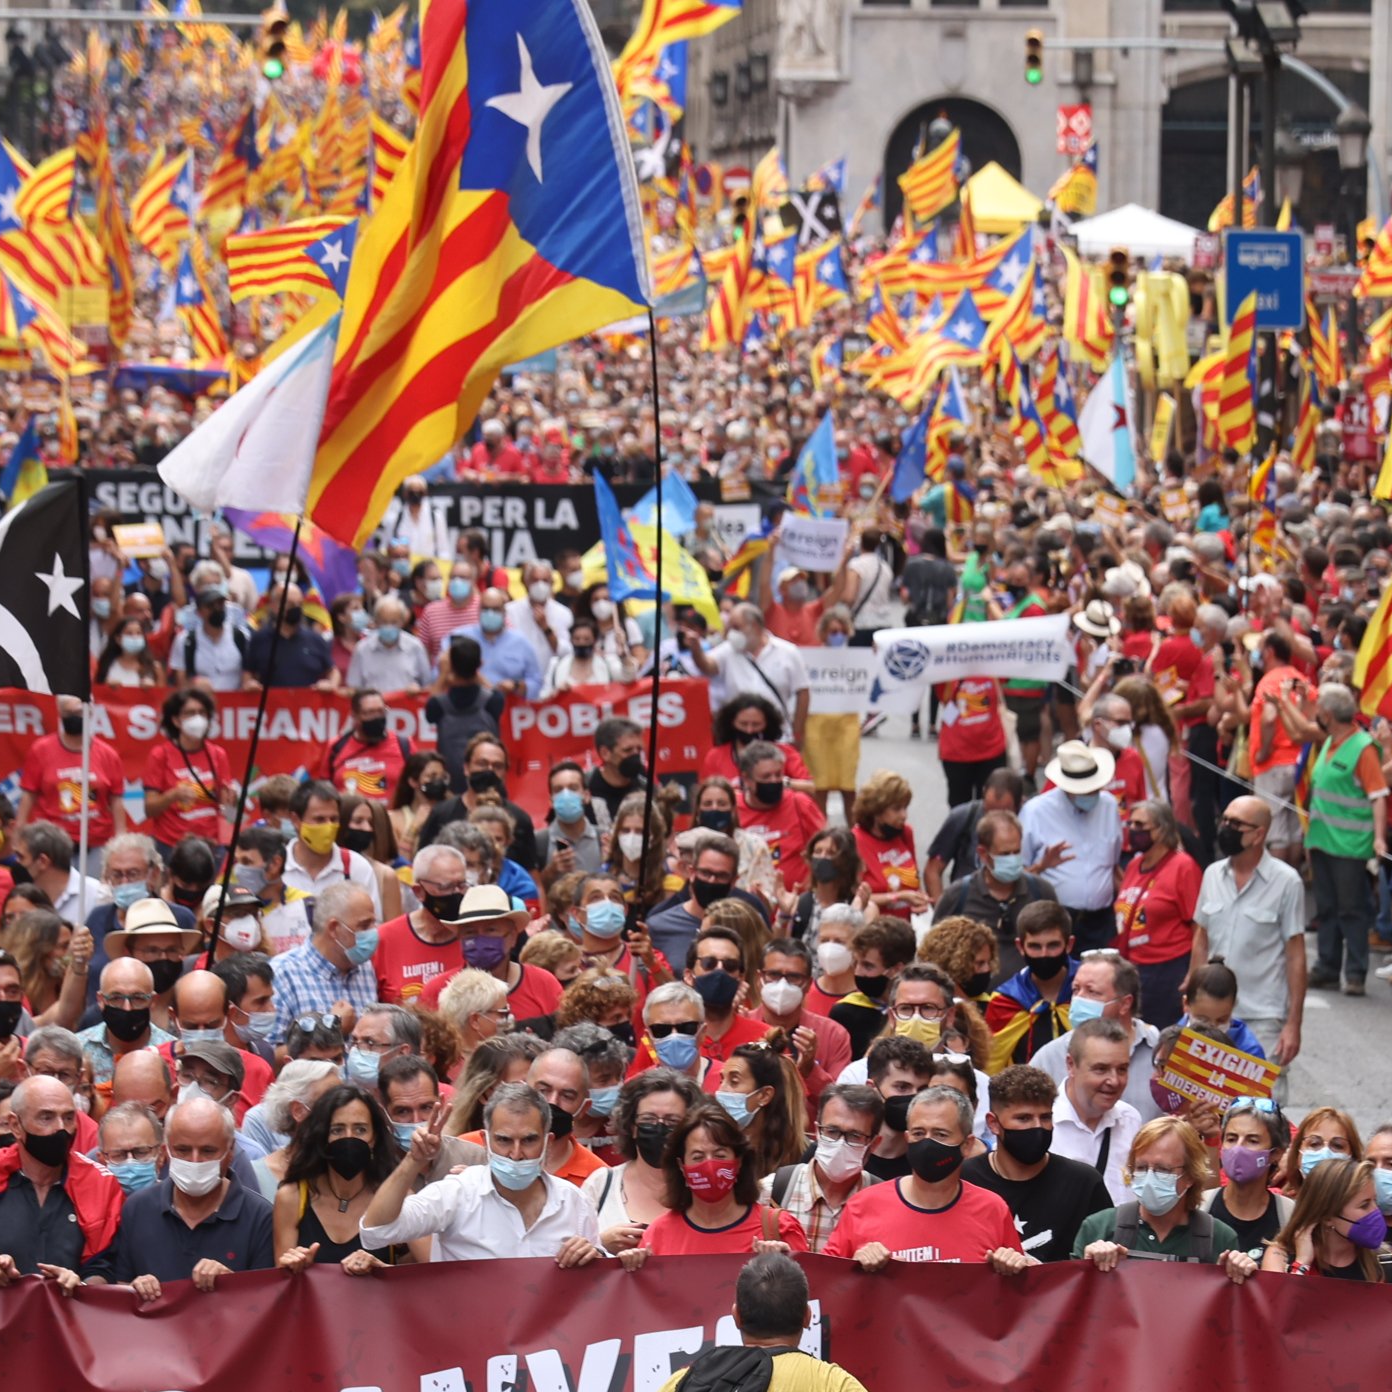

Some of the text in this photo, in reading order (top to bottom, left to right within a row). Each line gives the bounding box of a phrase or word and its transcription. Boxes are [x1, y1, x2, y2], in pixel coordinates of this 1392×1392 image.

[1257, 292, 1280, 312] axi
[460, 497, 527, 528] PER
[534, 500, 580, 530] LA
[1188, 1039, 1266, 1083] EXIGIM
[1208, 1069, 1225, 1088] LA
